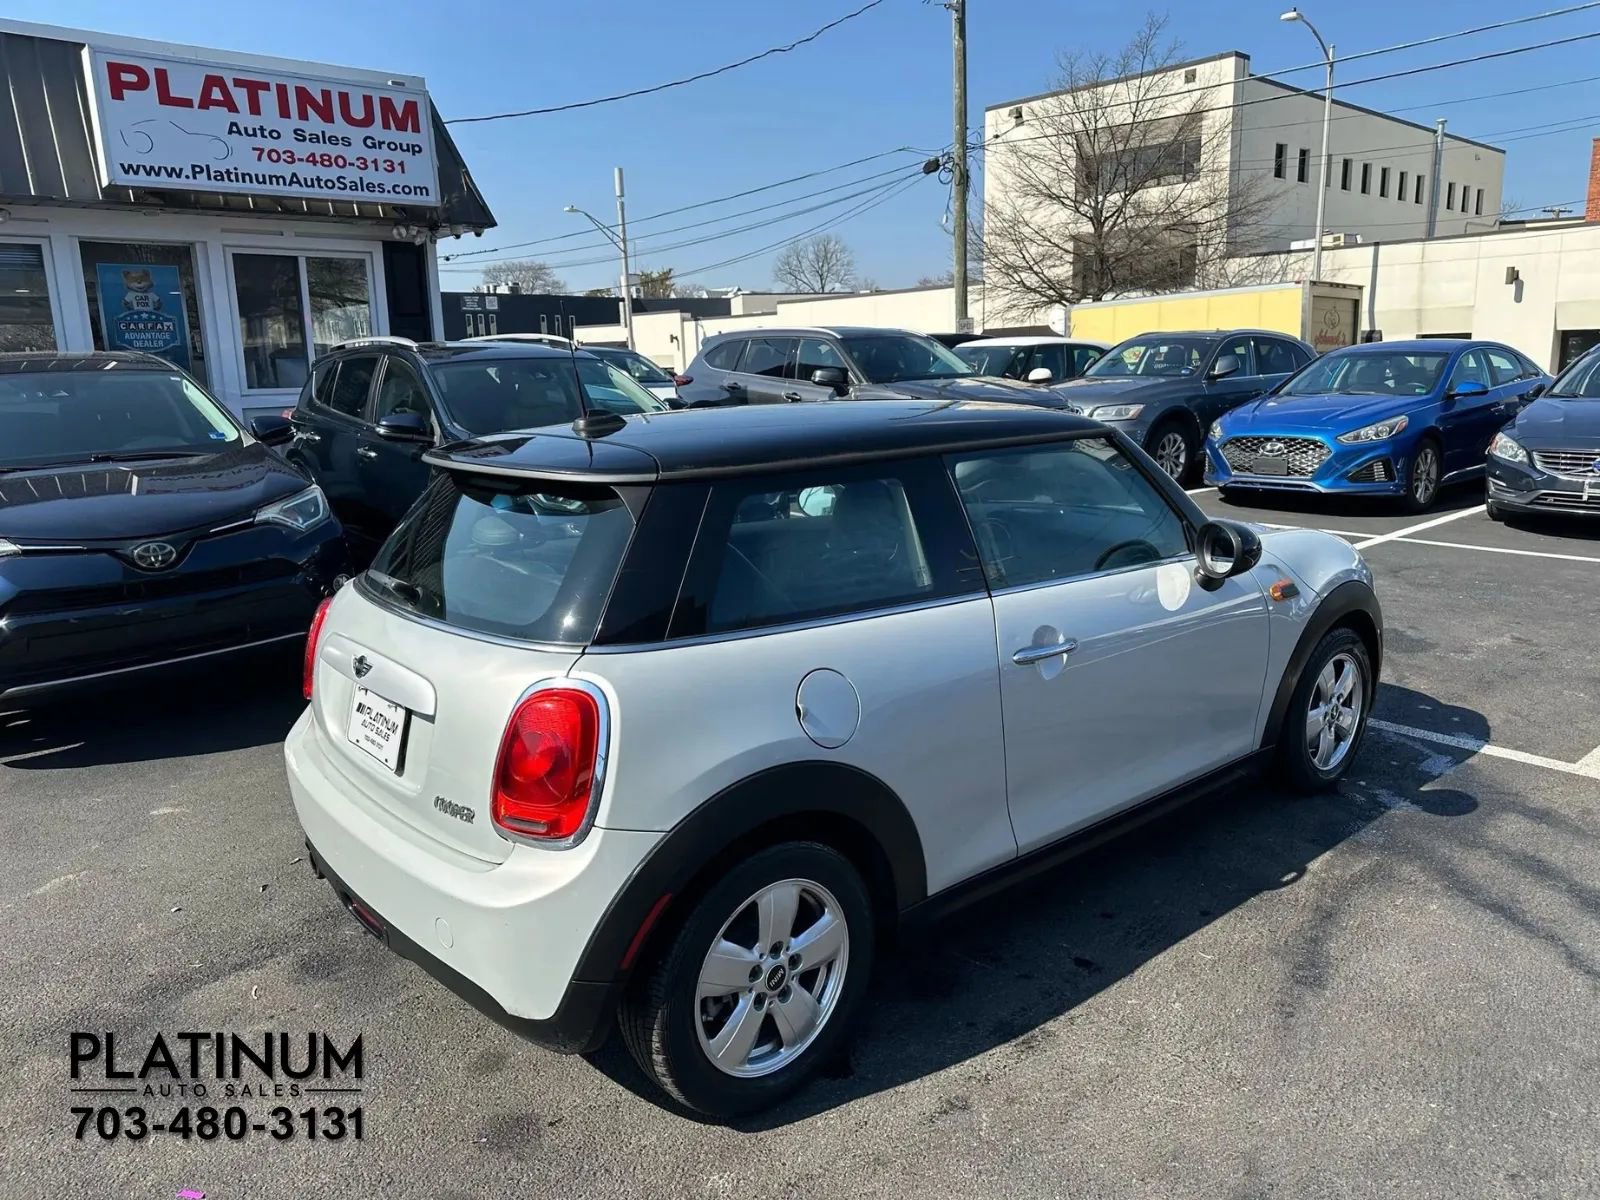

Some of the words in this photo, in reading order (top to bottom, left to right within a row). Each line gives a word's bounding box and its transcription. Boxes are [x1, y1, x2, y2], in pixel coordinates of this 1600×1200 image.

[106, 61, 421, 134] PLATINUM
[227, 121, 282, 140] Auto
[293, 128, 352, 148] Sales
[362, 135, 423, 156] Group
[252, 147, 406, 174] 703-480-3131
[119, 162, 430, 197] www.PlatinumAutoSales.com
[120, 322, 173, 331] CARFAX
[124, 332, 171, 340] ADVANTAGE
[361, 719, 376, 732] AUTO
[375, 726, 390, 742] SALES
[364, 705, 399, 736] PLATINUM
